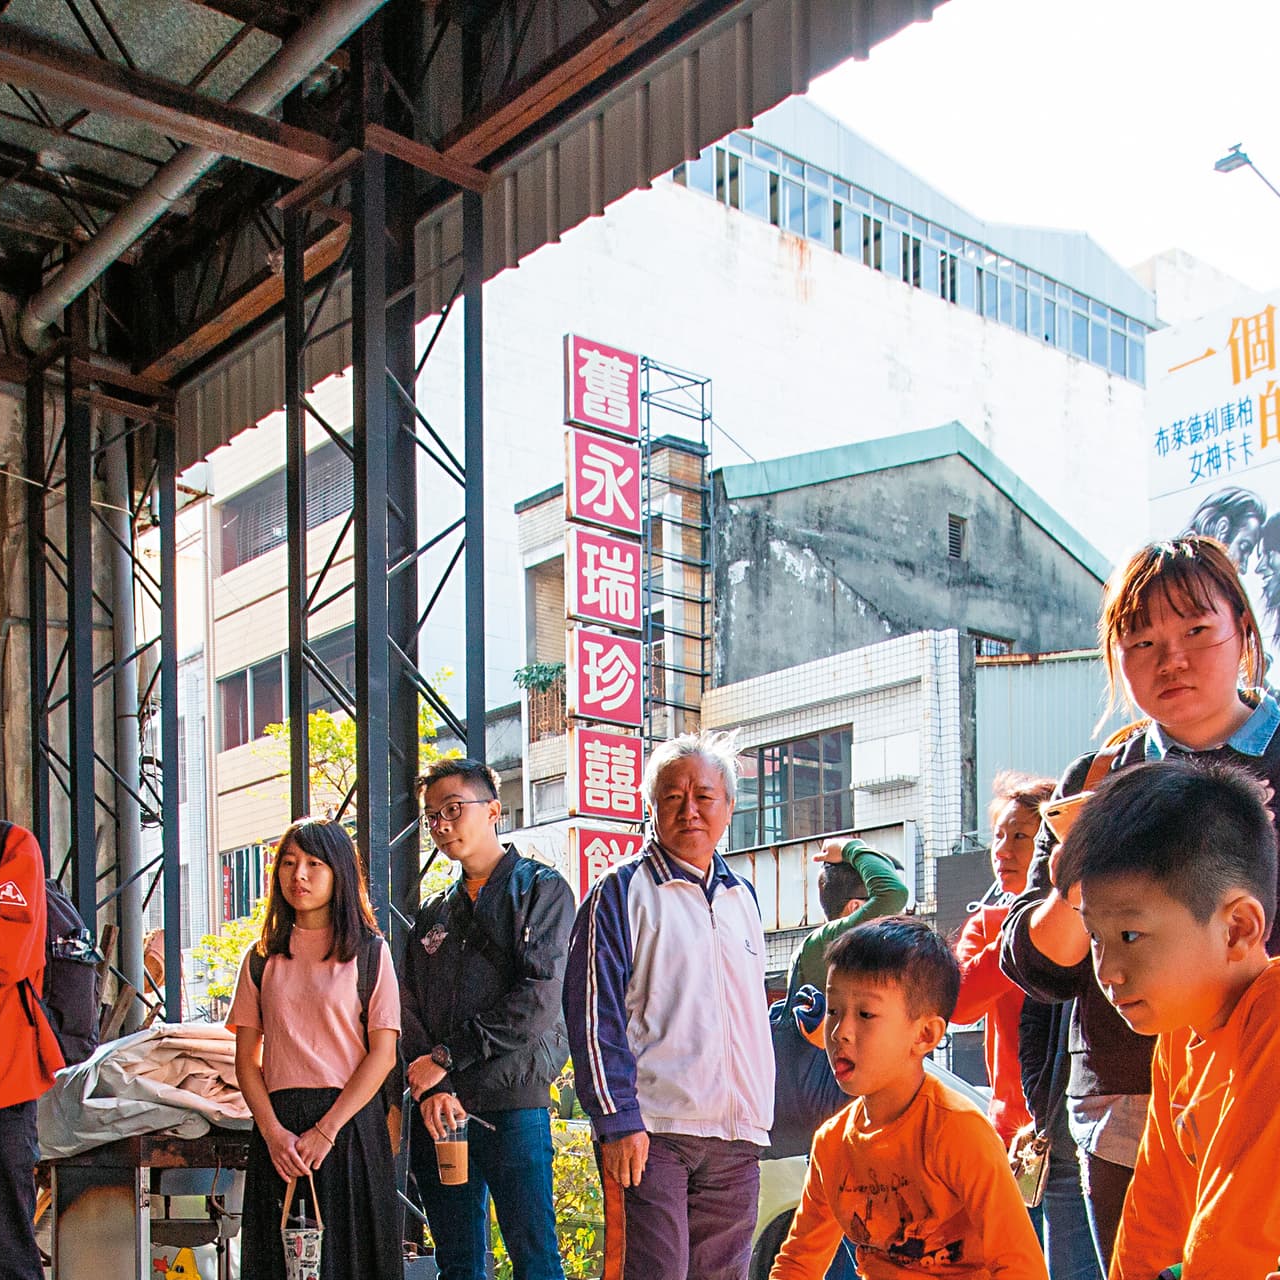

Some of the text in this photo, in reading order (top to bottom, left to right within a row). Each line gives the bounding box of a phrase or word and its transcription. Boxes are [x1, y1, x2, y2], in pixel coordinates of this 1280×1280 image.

[1154, 394, 1253, 458] 布萊德利庫柏
[1188, 432, 1254, 484] 女神卡卡
